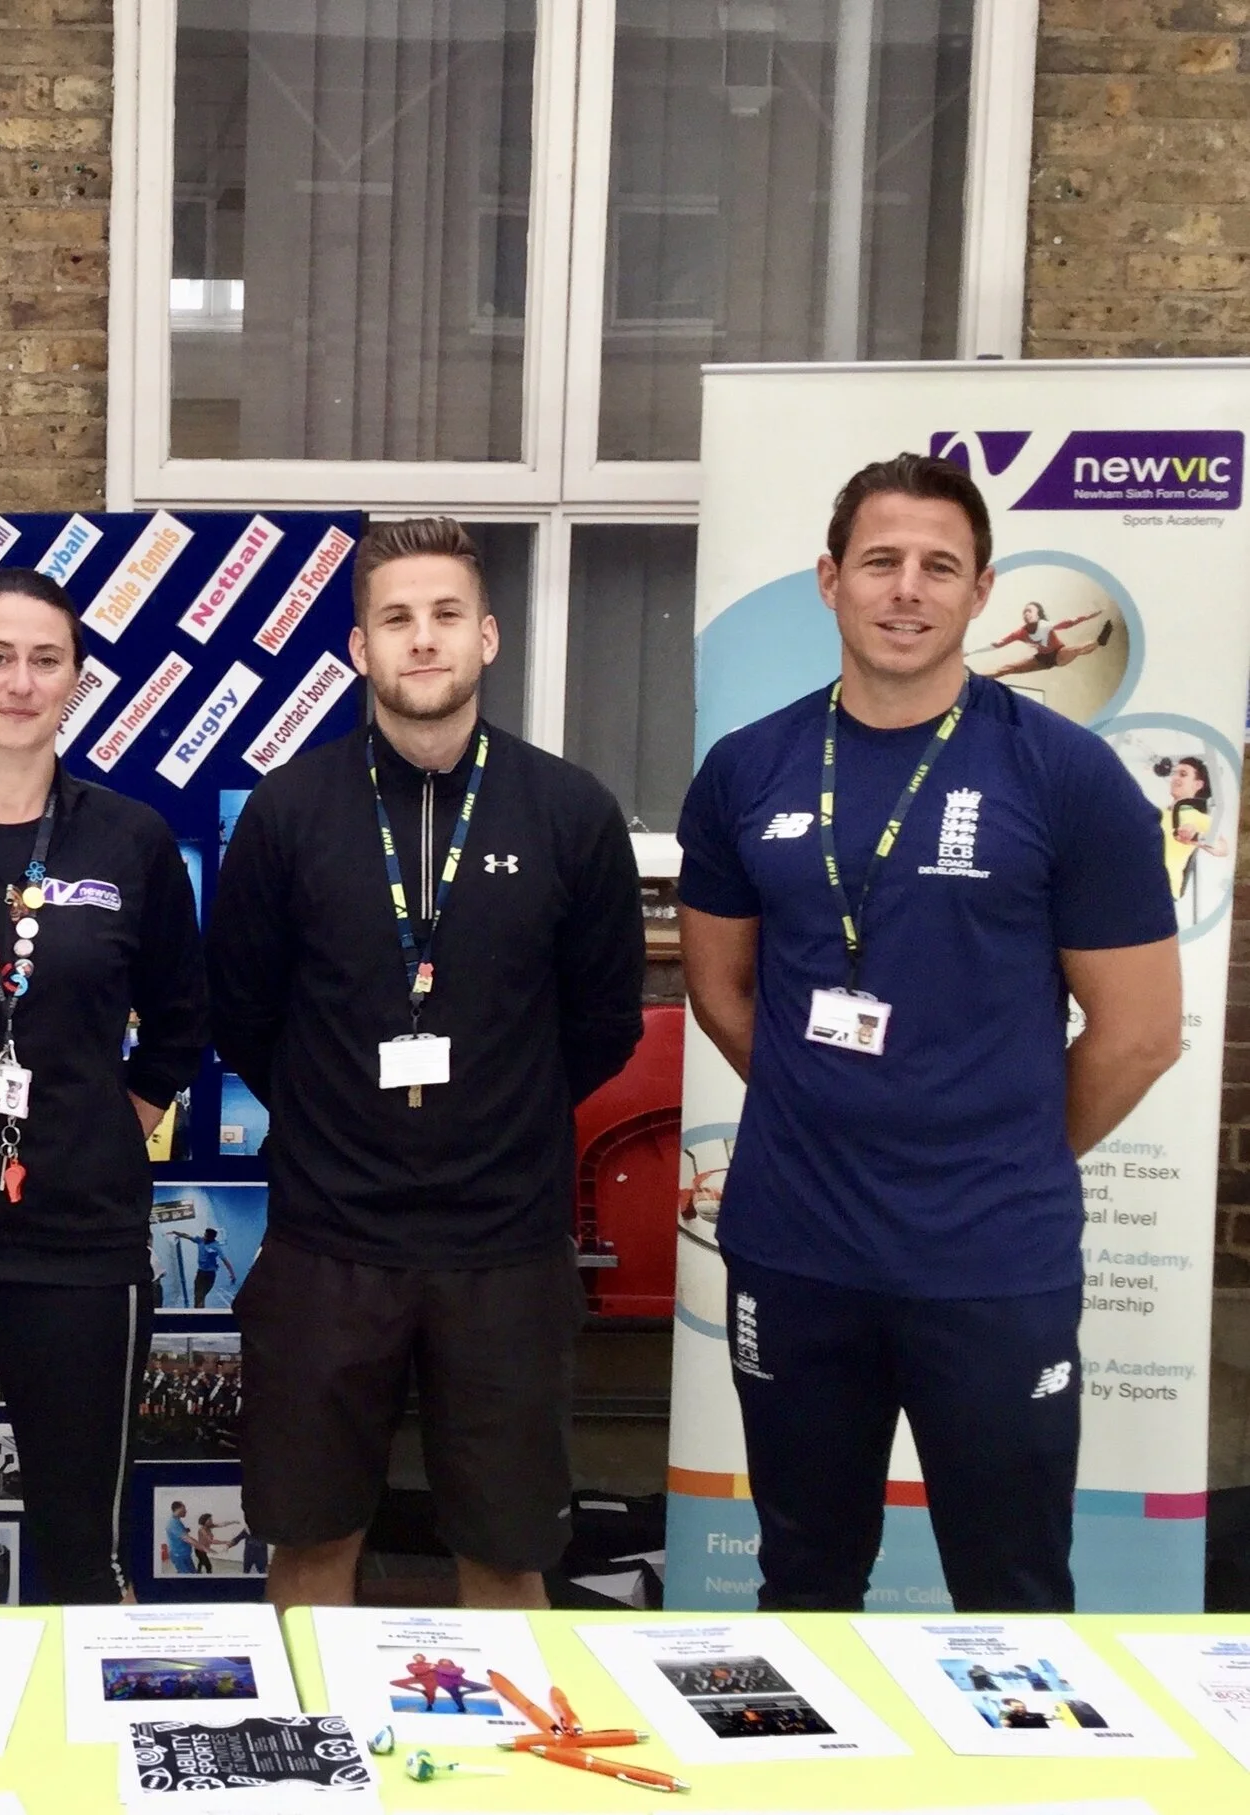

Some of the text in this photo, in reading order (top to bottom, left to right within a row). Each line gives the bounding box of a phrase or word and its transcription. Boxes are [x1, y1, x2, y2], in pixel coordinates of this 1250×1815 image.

[1074, 456, 1232, 483] newvic
[1073, 488, 1230, 502] Newham Sixth Form College
[1123, 514, 1225, 528] Sports Academy
[94, 526, 182, 628] Table Tennis
[189, 525, 270, 628] Netball
[257, 530, 352, 651] Women's Football
[95, 660, 185, 762] Gym Inductions
[250, 663, 346, 768] Non contact boxing
[175, 687, 241, 764] Rugby
[937, 858, 974, 869] COACH
[938, 843, 974, 859] ECB
[824, 855, 840, 886] STAFF
[917, 866, 992, 879] DEVELOPMENT
[1123, 1162, 1181, 1180] Essex
[1113, 1208, 1158, 1227] level
[1109, 1272, 1159, 1293] level,
[1090, 1381, 1179, 1402] by Sports
[706, 1532, 762, 1557] Find
[170, 1733, 199, 1775] ABILITY
[191, 1732, 219, 1775] SPORTS
